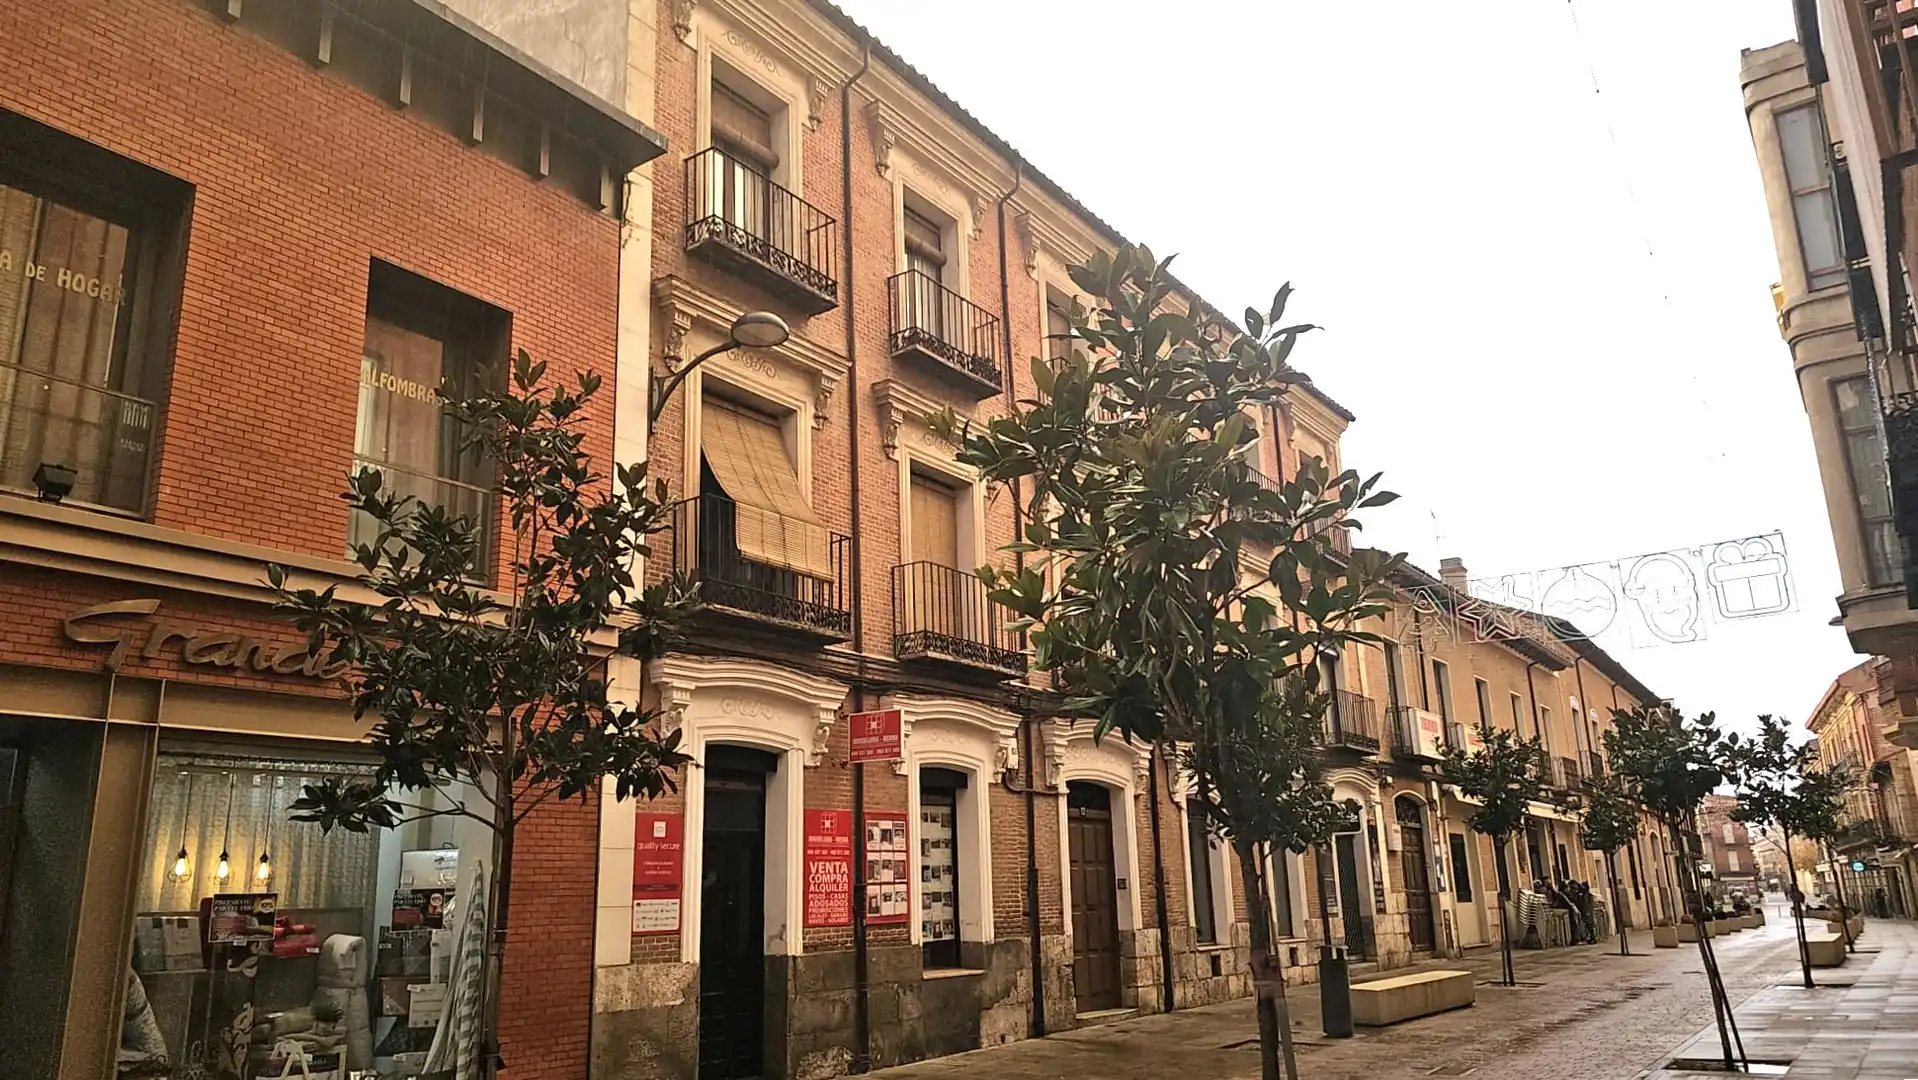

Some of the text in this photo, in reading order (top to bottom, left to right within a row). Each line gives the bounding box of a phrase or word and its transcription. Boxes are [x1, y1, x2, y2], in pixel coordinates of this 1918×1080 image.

[25, 261, 46, 282] DE
[57, 267, 125, 306] HOGAR
[809, 861, 848, 874] VENTA
[809, 873, 848, 884] COMPRA
[809, 883, 848, 892] ALQUILER
[809, 899, 848, 908] ADOSADOS
